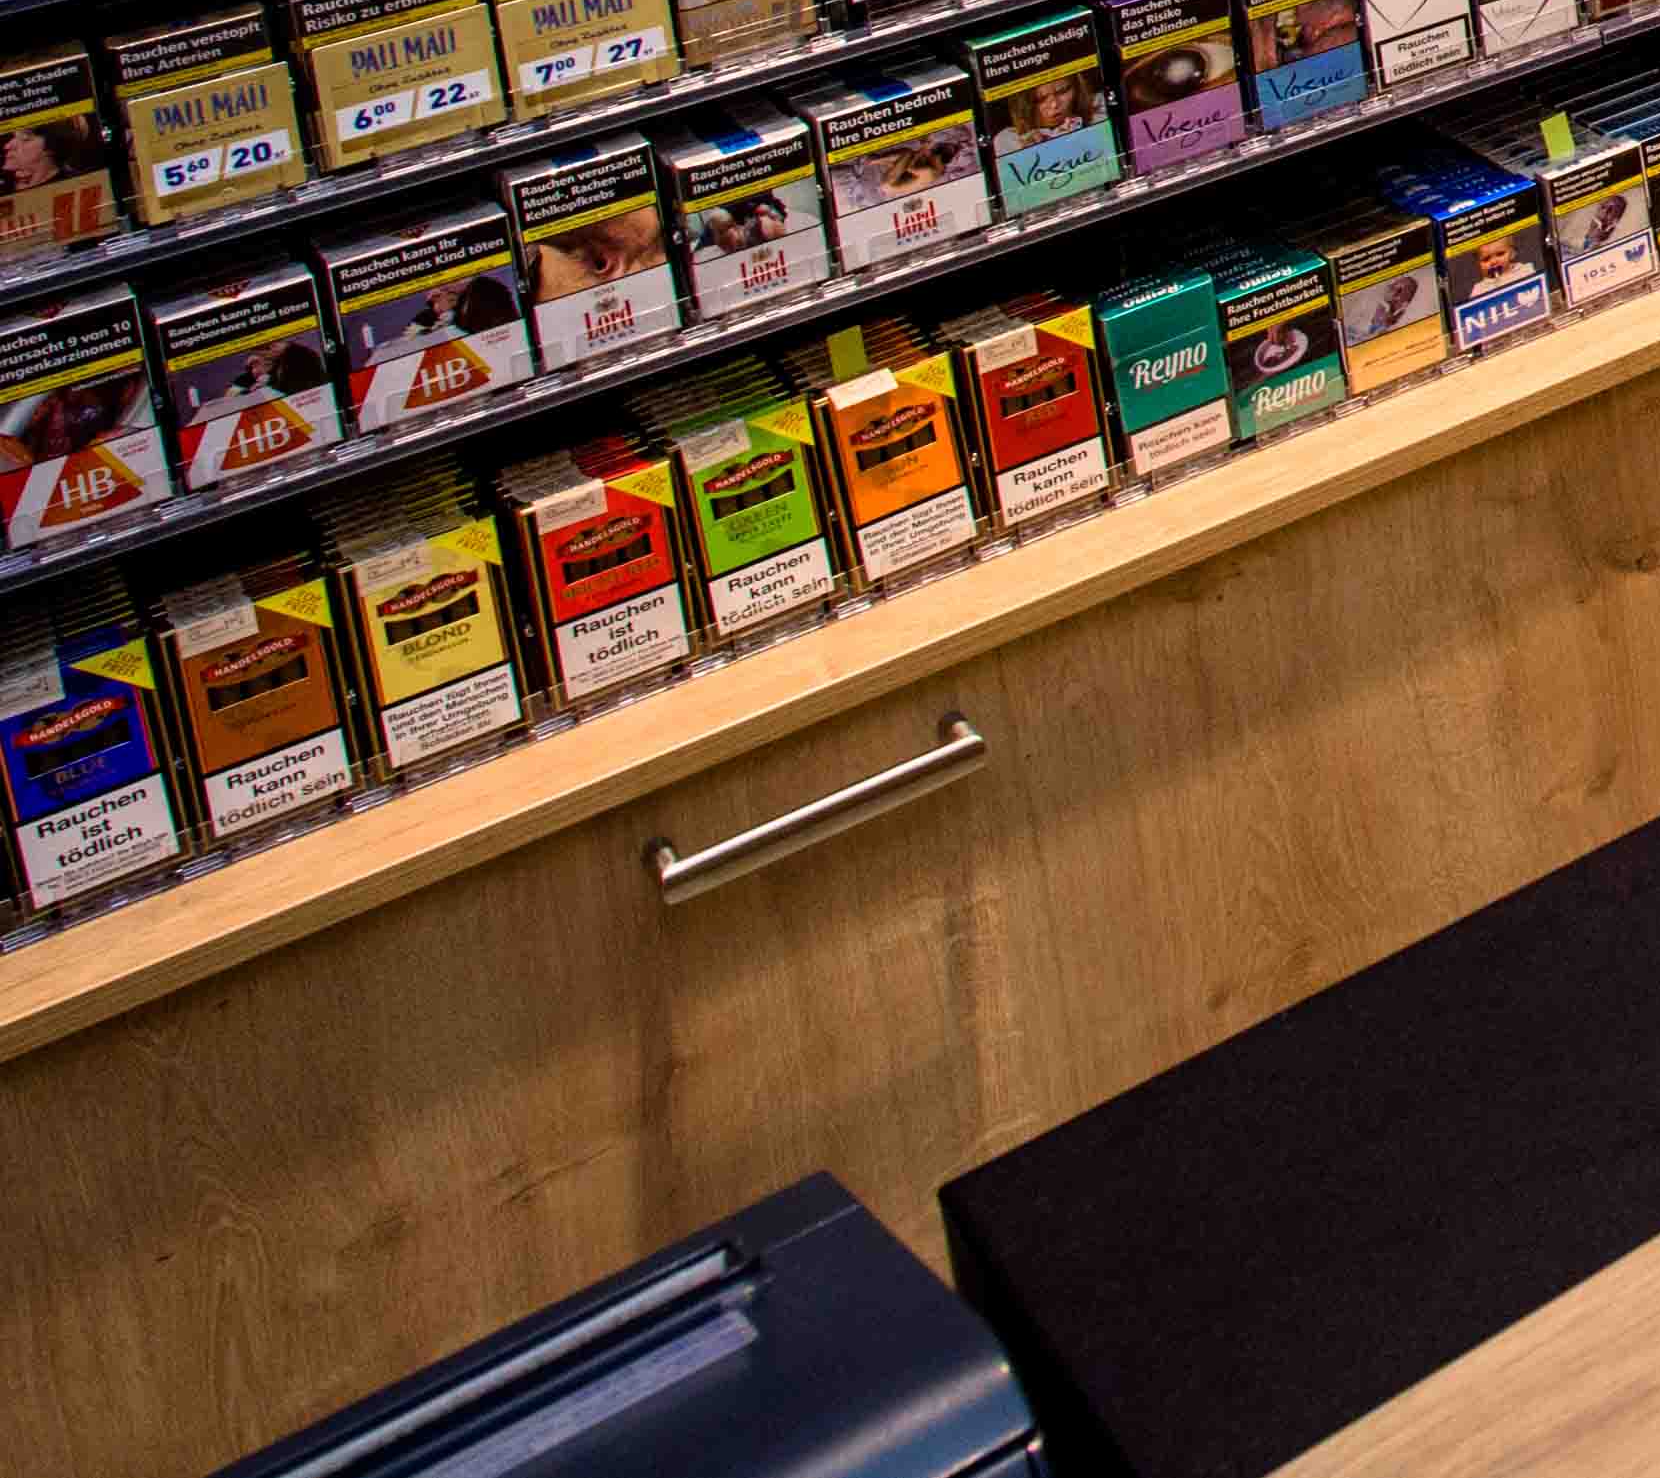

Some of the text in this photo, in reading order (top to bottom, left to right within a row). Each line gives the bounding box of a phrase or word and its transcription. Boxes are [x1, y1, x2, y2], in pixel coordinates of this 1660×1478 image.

[1461, 297, 1519, 346] NIL
[1129, 337, 1208, 391] Reyno
[60, 466, 117, 511] HB
[34, 786, 149, 842] Rauchen
[79, 816, 113, 843] ist
[55, 823, 144, 870] tödlich
